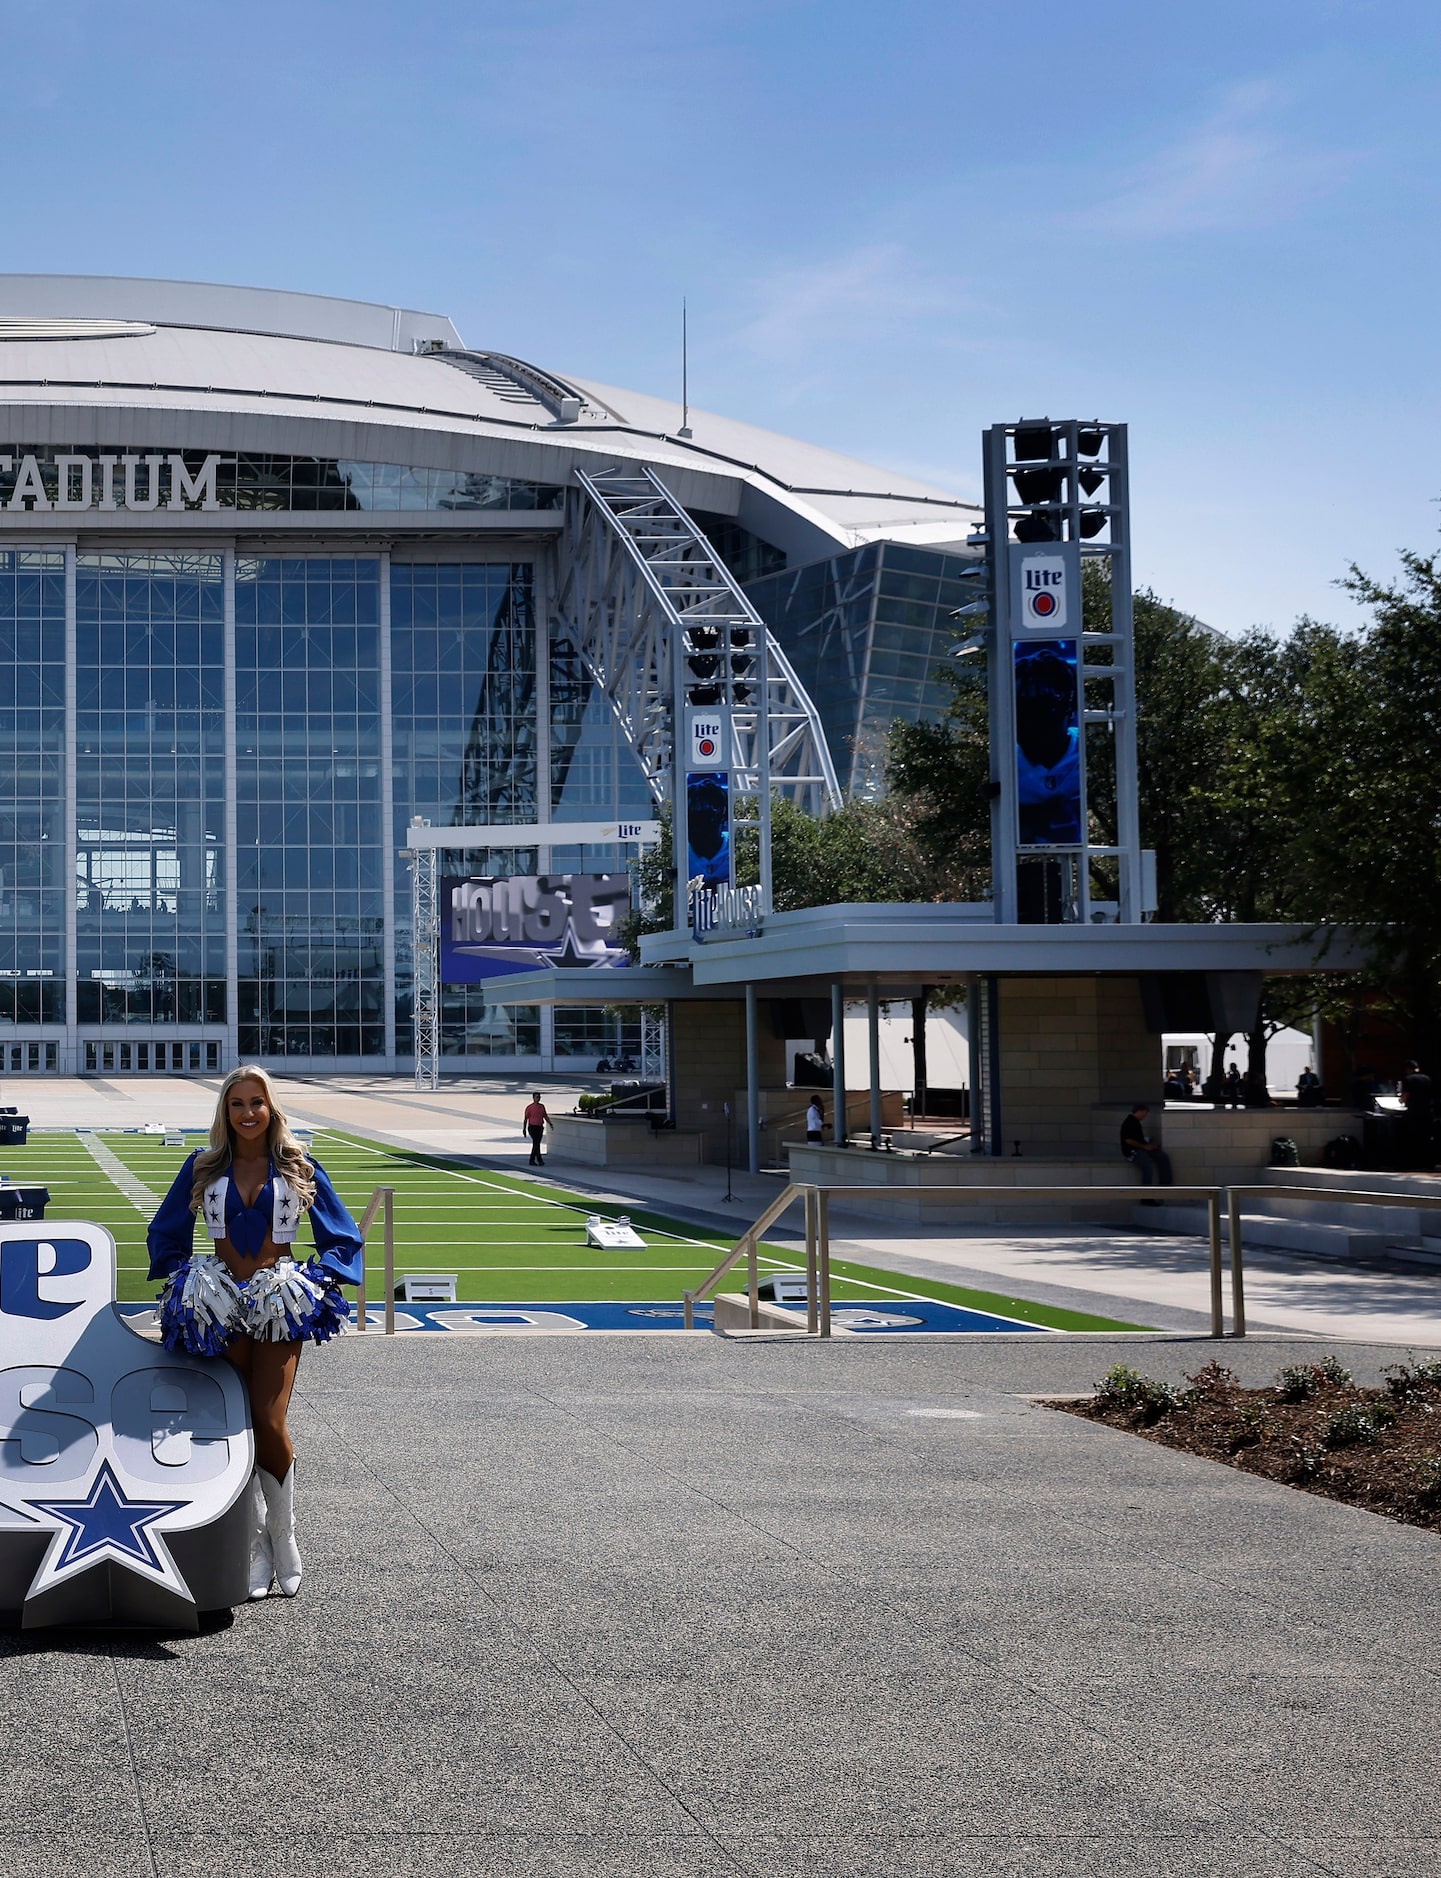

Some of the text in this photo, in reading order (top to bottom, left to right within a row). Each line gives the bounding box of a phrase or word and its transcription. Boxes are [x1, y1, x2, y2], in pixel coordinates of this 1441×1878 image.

[1024, 570, 1063, 591] Lite
[694, 724, 719, 739] Lite
[617, 825, 642, 839] Lite
